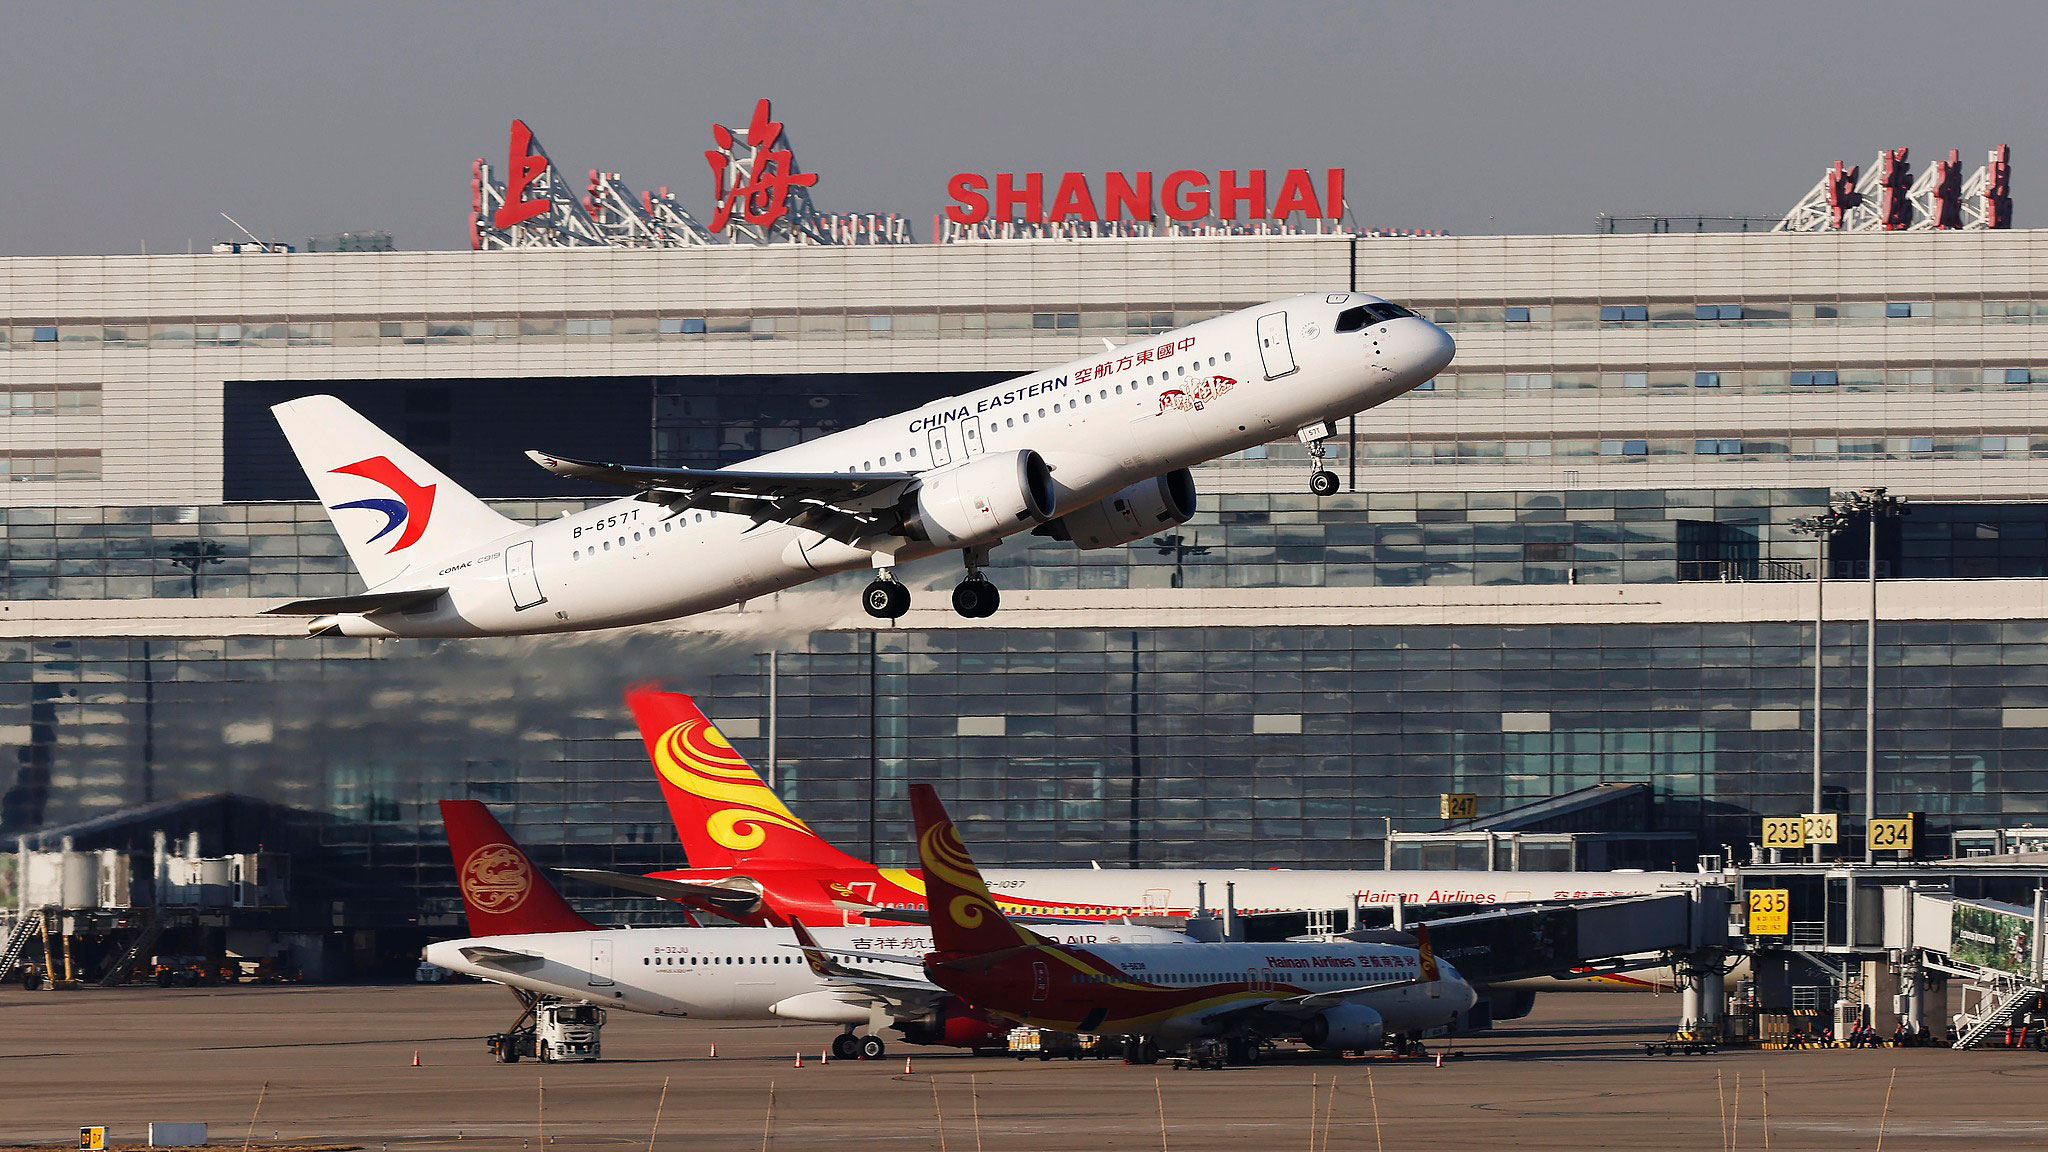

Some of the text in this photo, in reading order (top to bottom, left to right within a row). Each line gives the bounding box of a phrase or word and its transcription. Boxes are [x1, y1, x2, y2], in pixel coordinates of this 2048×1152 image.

[495, 98, 818, 233] 上海
[944, 168, 1345, 224] SHANGHAI
[909, 375, 1068, 433] CHINA EASTERN
[573, 508, 641, 539] B-657T
[438, 552, 501, 576] COMAC C919
[1451, 797, 1474, 816] 247
[1767, 822, 1800, 843] 235
[1804, 818, 1833, 839] 236
[1873, 823, 1909, 845] 234
[1426, 890, 1497, 904] Airlines
[1751, 893, 1786, 912] 235
[1066, 935, 1098, 945] AIR
[1265, 955, 1357, 969] Hainan Airlines
